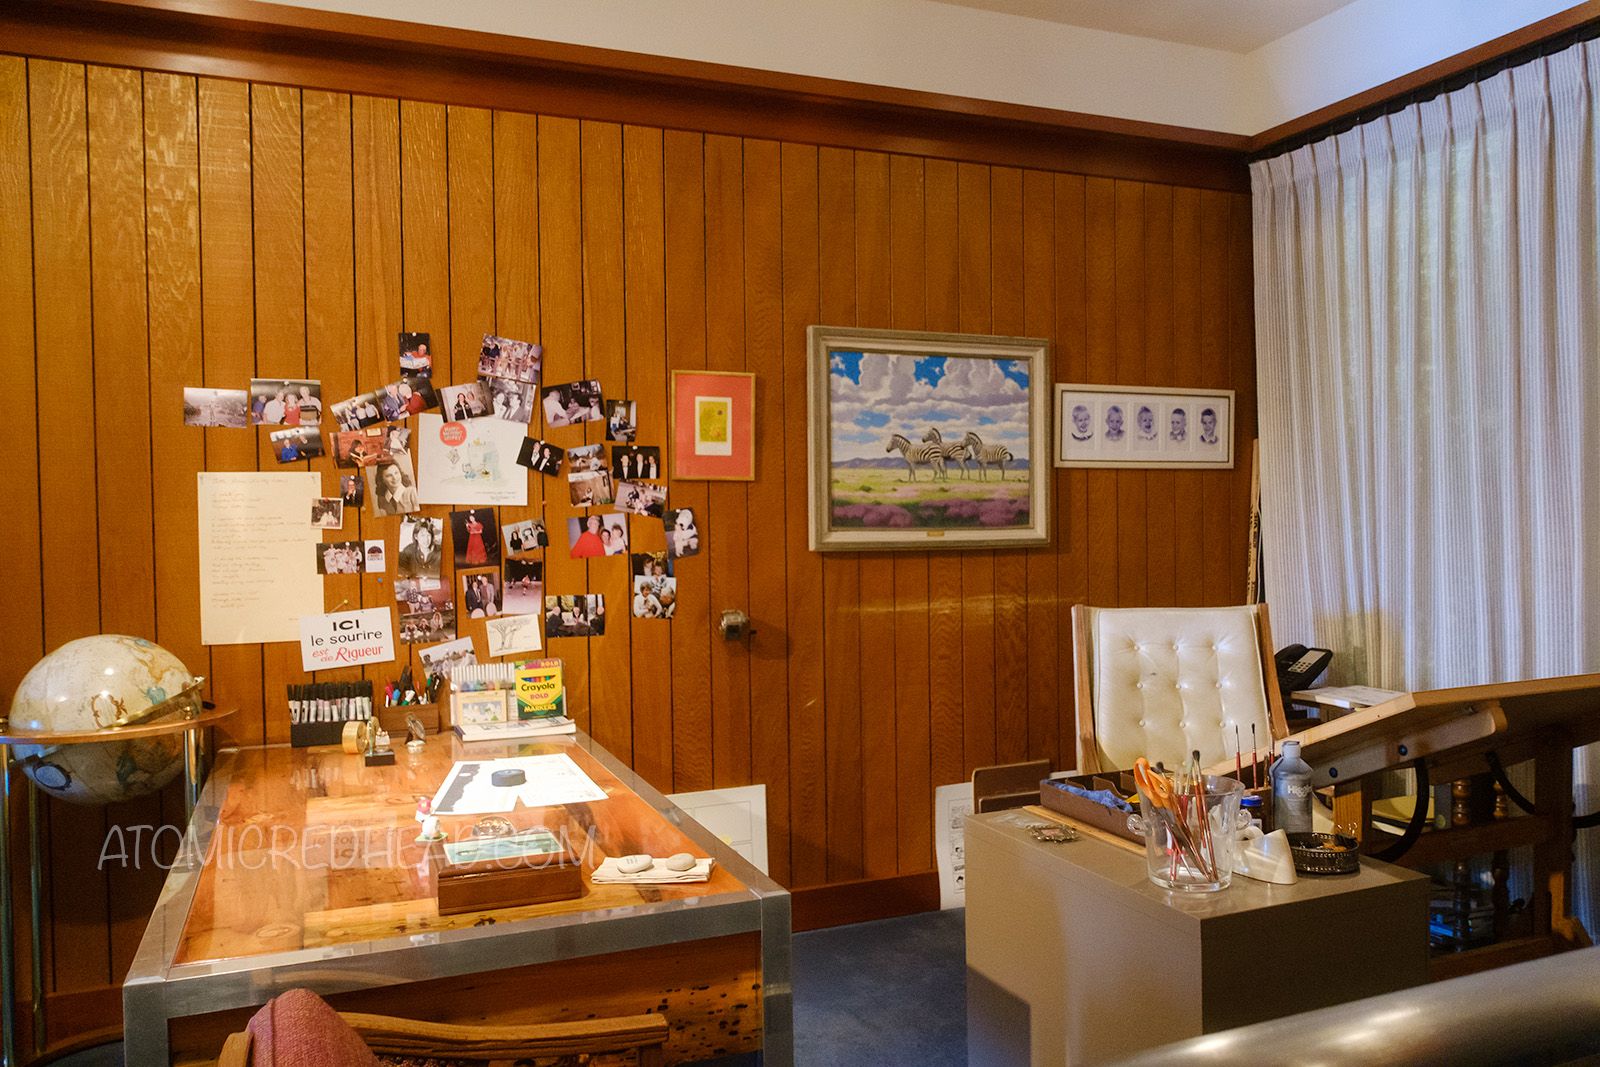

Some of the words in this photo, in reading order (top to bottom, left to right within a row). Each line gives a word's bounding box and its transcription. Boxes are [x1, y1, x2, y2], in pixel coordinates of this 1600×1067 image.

[332, 619, 360, 631] ICI
[310, 635, 324, 646] le
[329, 631, 382, 644] sourire
[312, 648, 329, 658] est
[334, 645, 384, 663] Rigueur
[521, 682, 555, 692] Crayola
[524, 704, 557, 712] MARKERS
